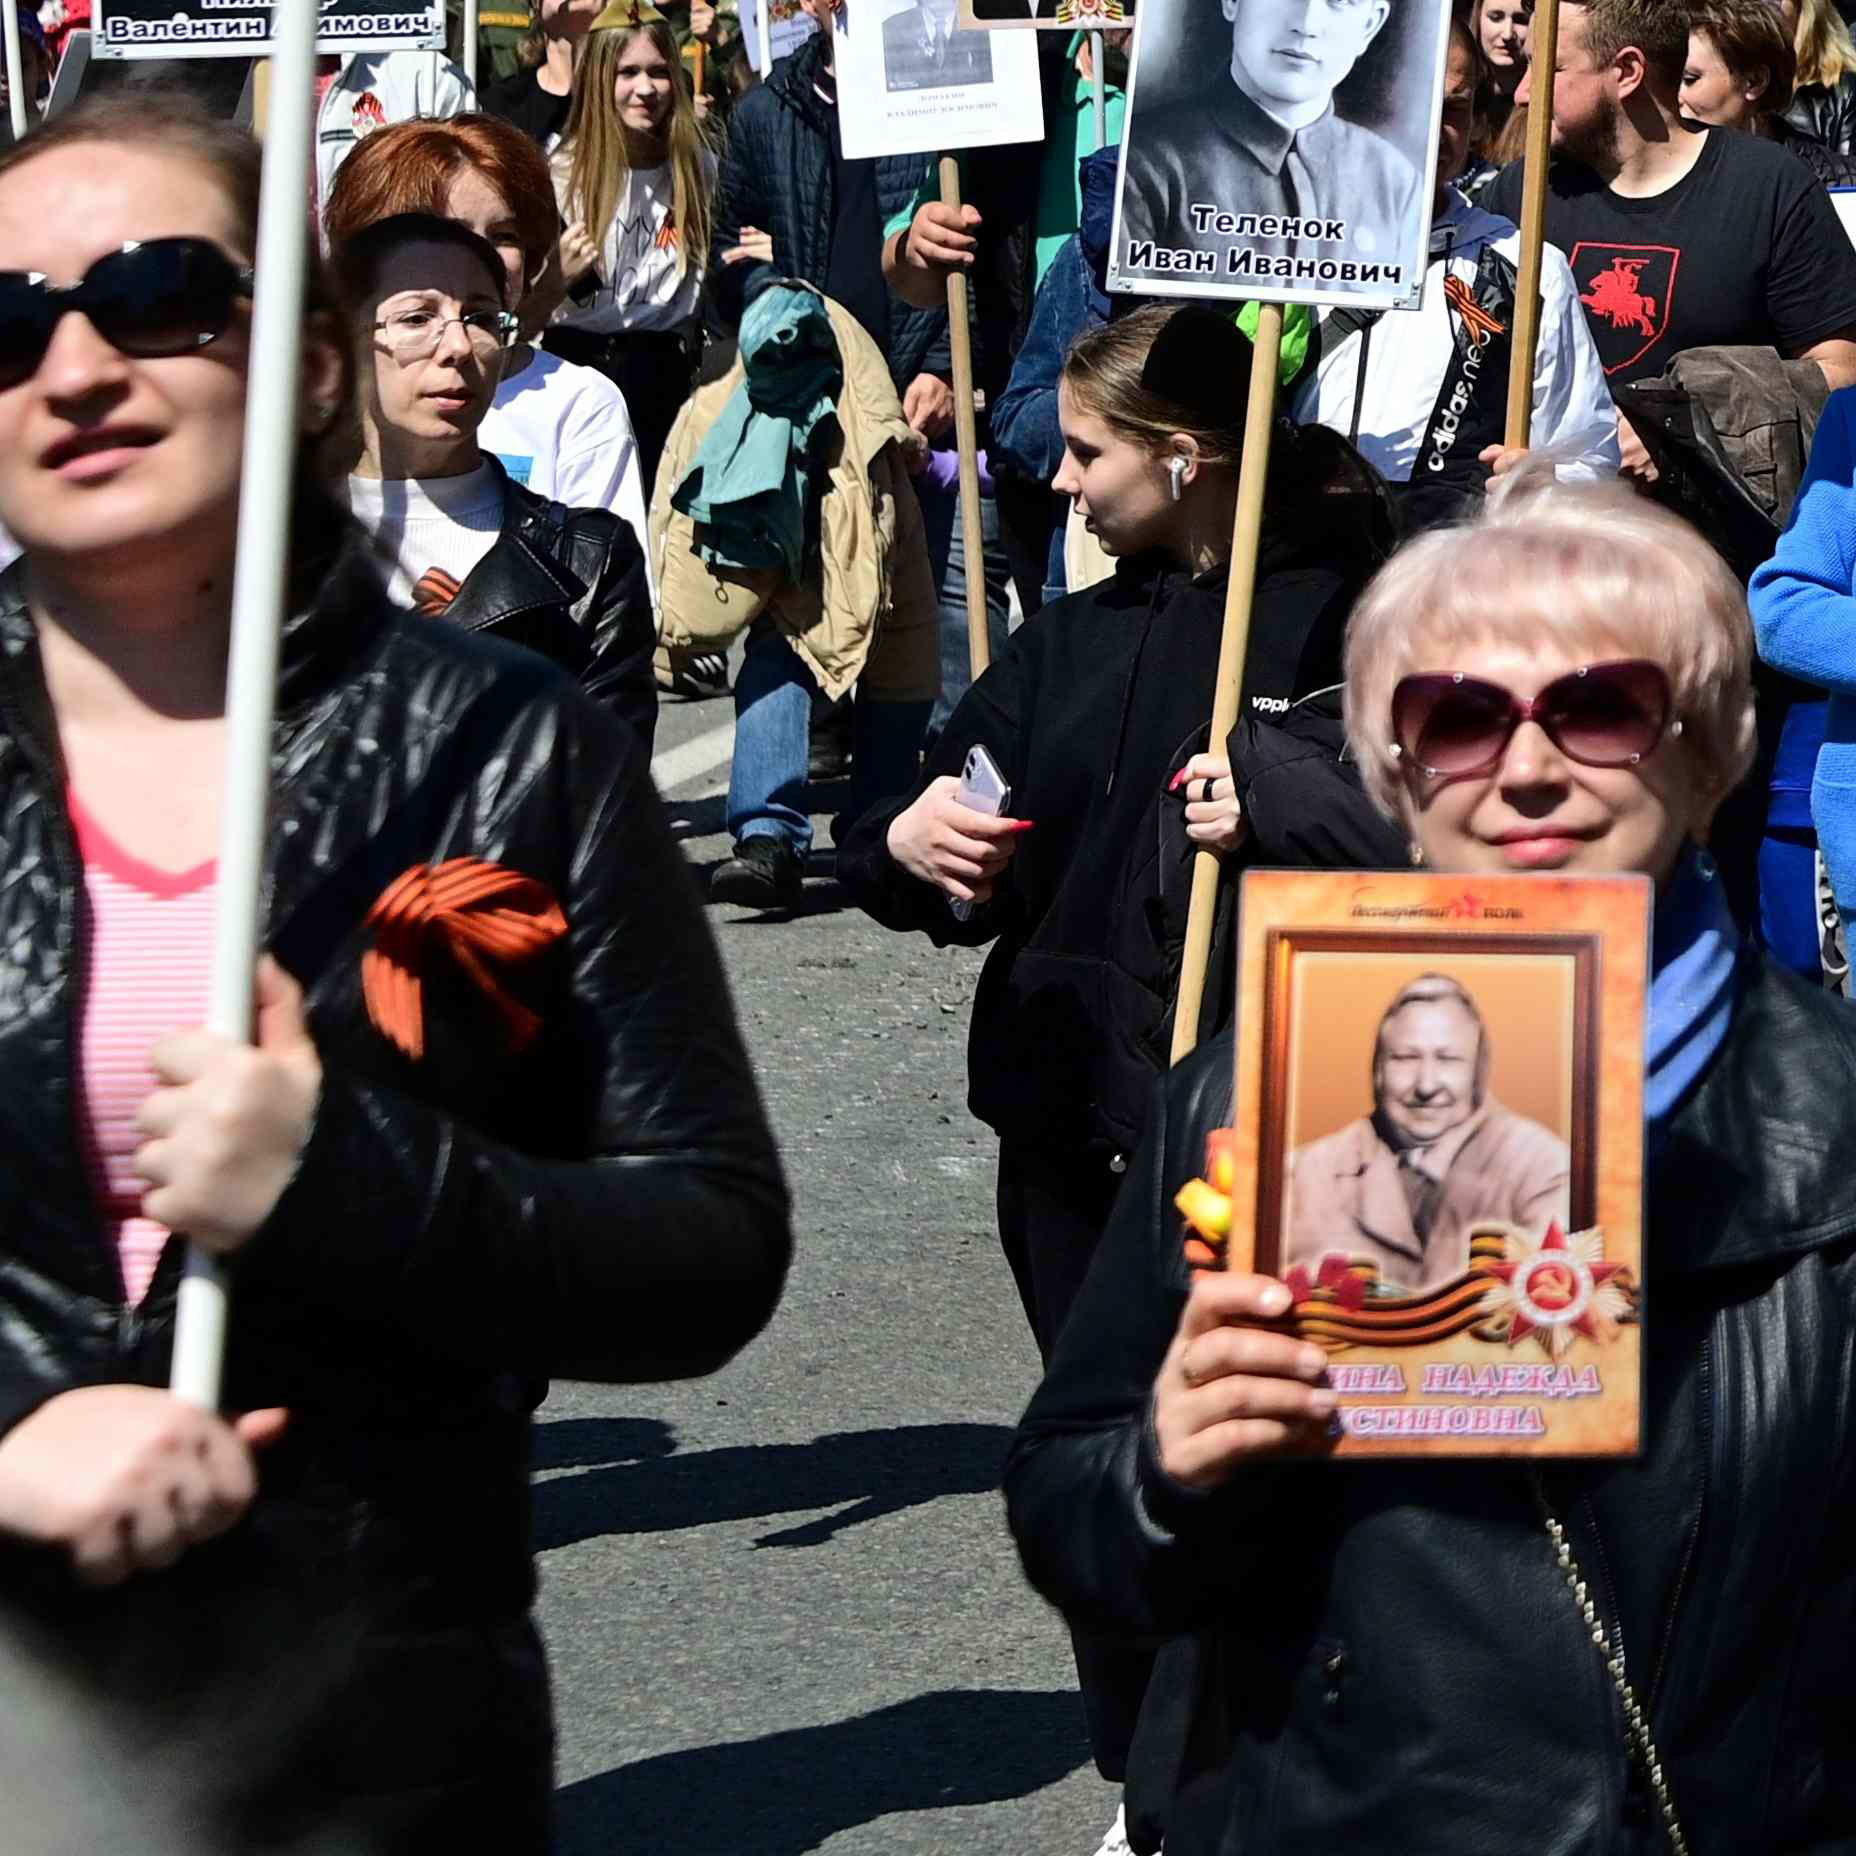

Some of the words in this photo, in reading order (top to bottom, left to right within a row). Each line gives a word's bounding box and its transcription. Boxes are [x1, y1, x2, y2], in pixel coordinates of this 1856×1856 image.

[107, 16, 264, 41] Валентин
[1193, 205, 1345, 240] Теленок
[1128, 242, 1216, 273] Иван
[1228, 248, 1402, 284] Иванович
[1420, 1362, 1604, 1400] НАДЕЖДА
